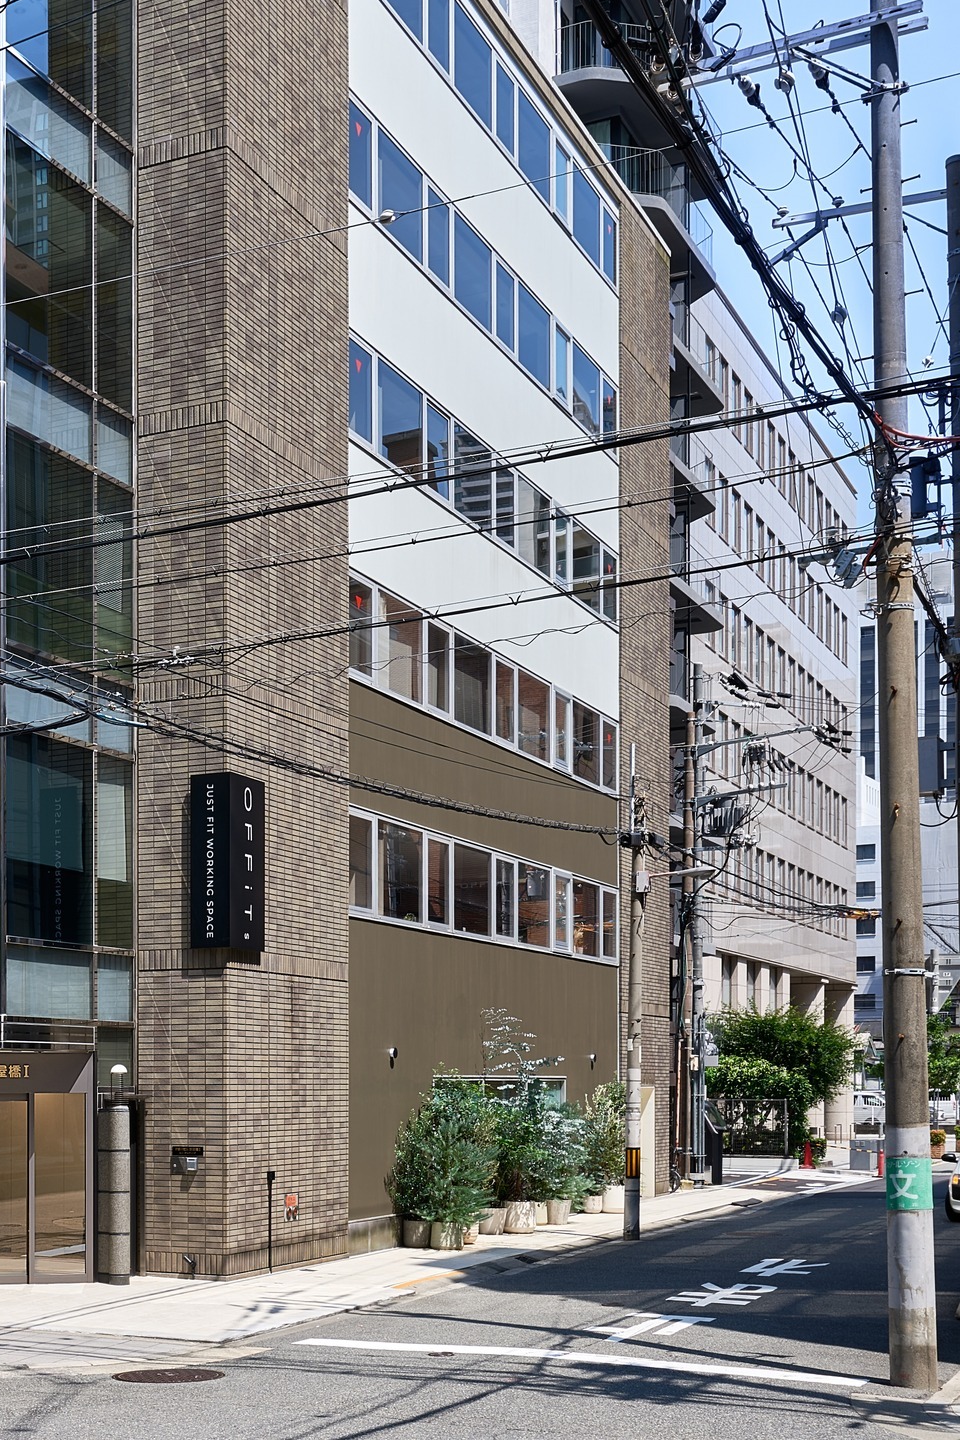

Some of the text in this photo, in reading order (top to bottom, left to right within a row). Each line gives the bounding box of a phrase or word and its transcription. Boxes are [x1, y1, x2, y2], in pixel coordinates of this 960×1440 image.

[206, 783, 215, 939] JUST FIT WORKING SPACE
